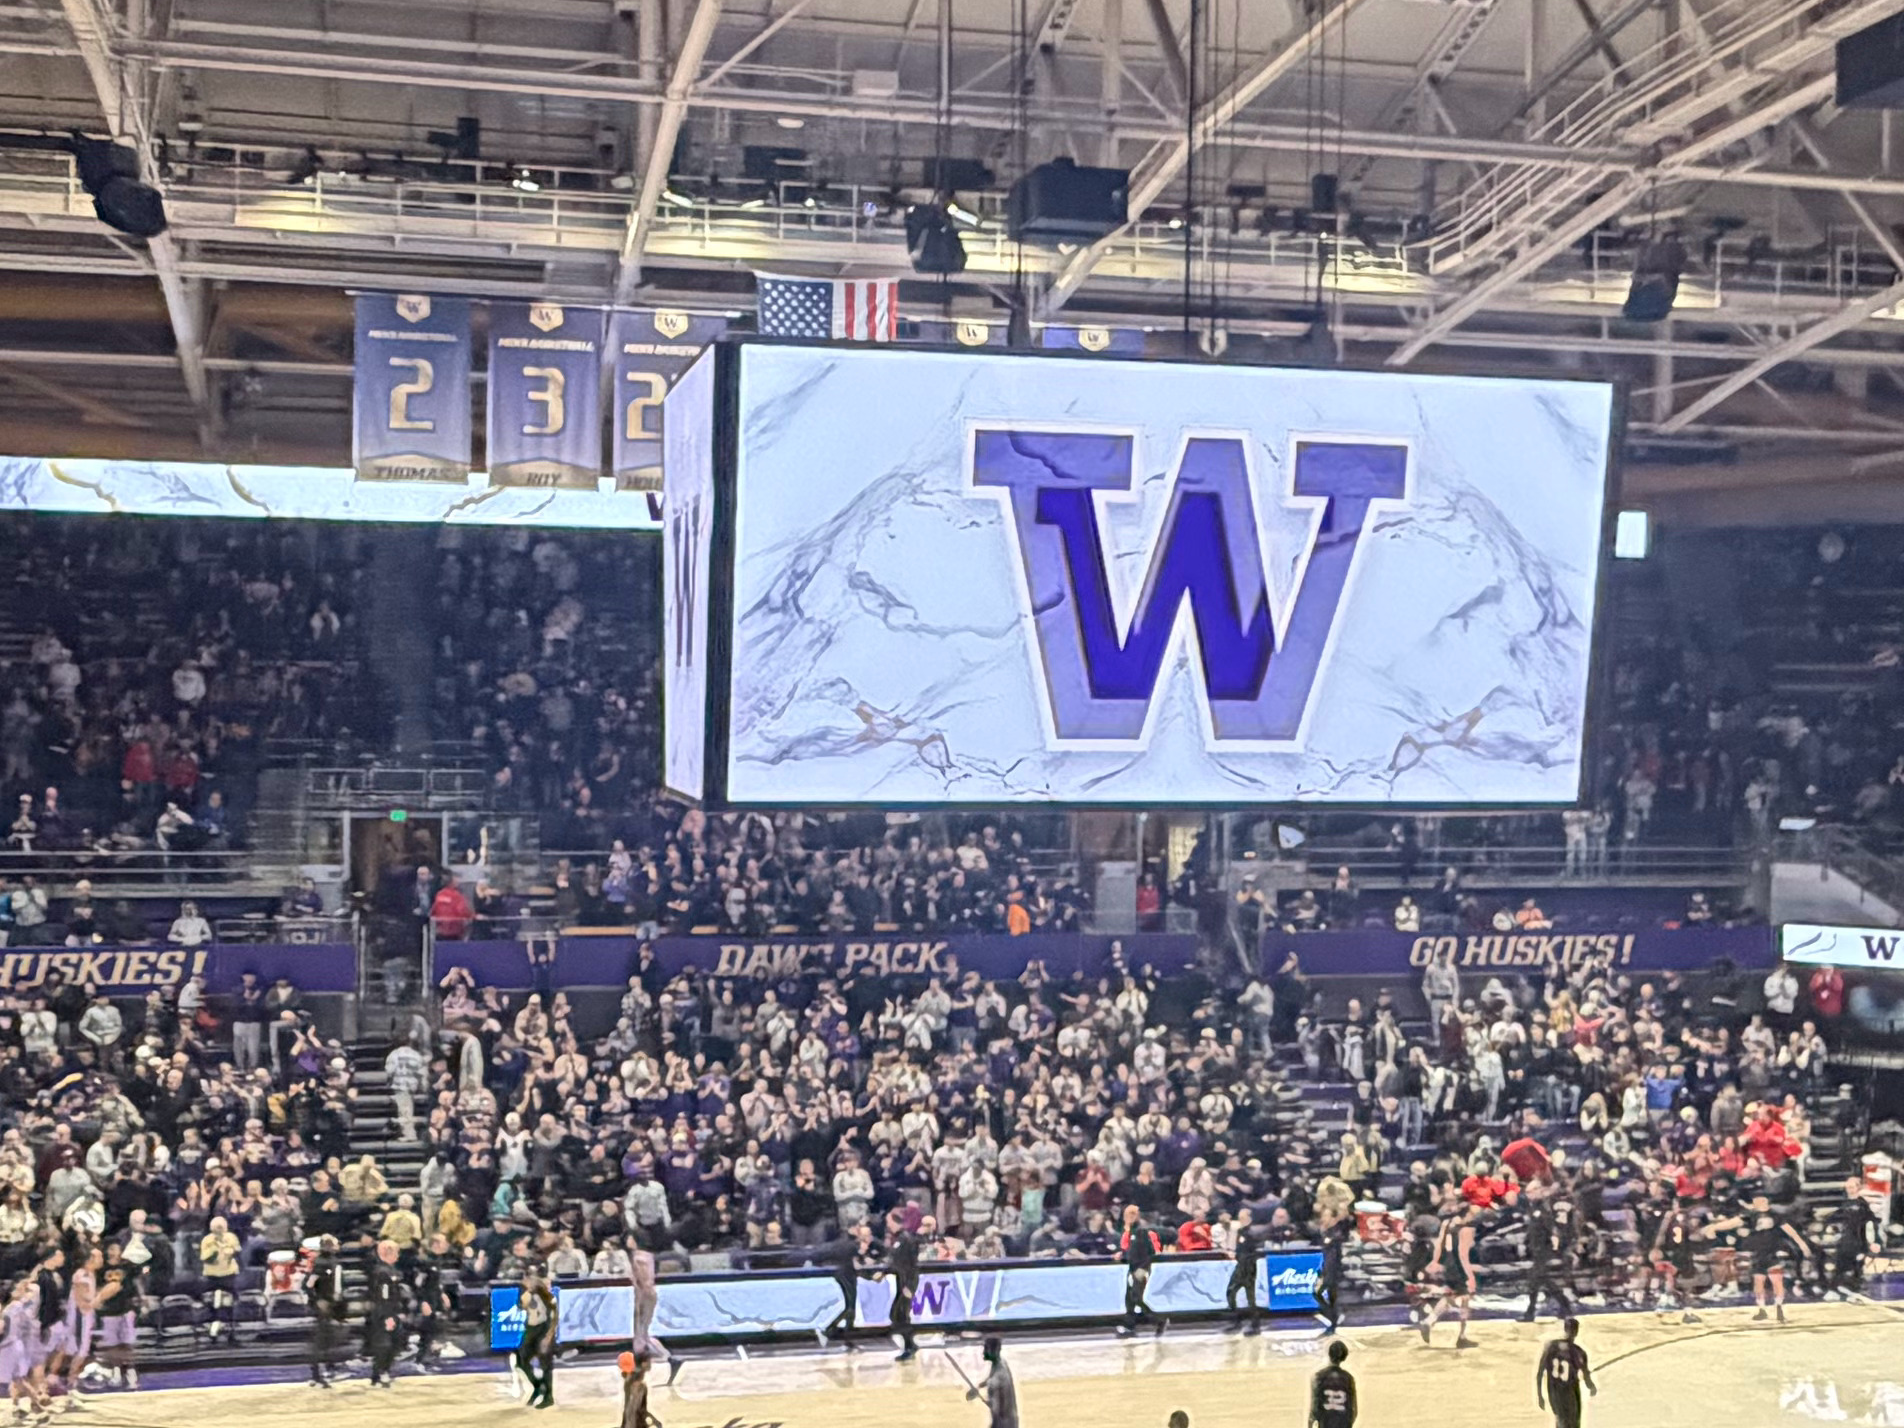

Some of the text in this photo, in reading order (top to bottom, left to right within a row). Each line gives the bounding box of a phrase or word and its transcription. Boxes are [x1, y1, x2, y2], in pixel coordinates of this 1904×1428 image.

[389, 357, 433, 430] 2
[523, 367, 566, 435] 3
[626, 372, 668, 440] 2
[964, 420, 1420, 752] W
[844, 942, 950, 977] PACK
[1860, 934, 1901, 961] W
